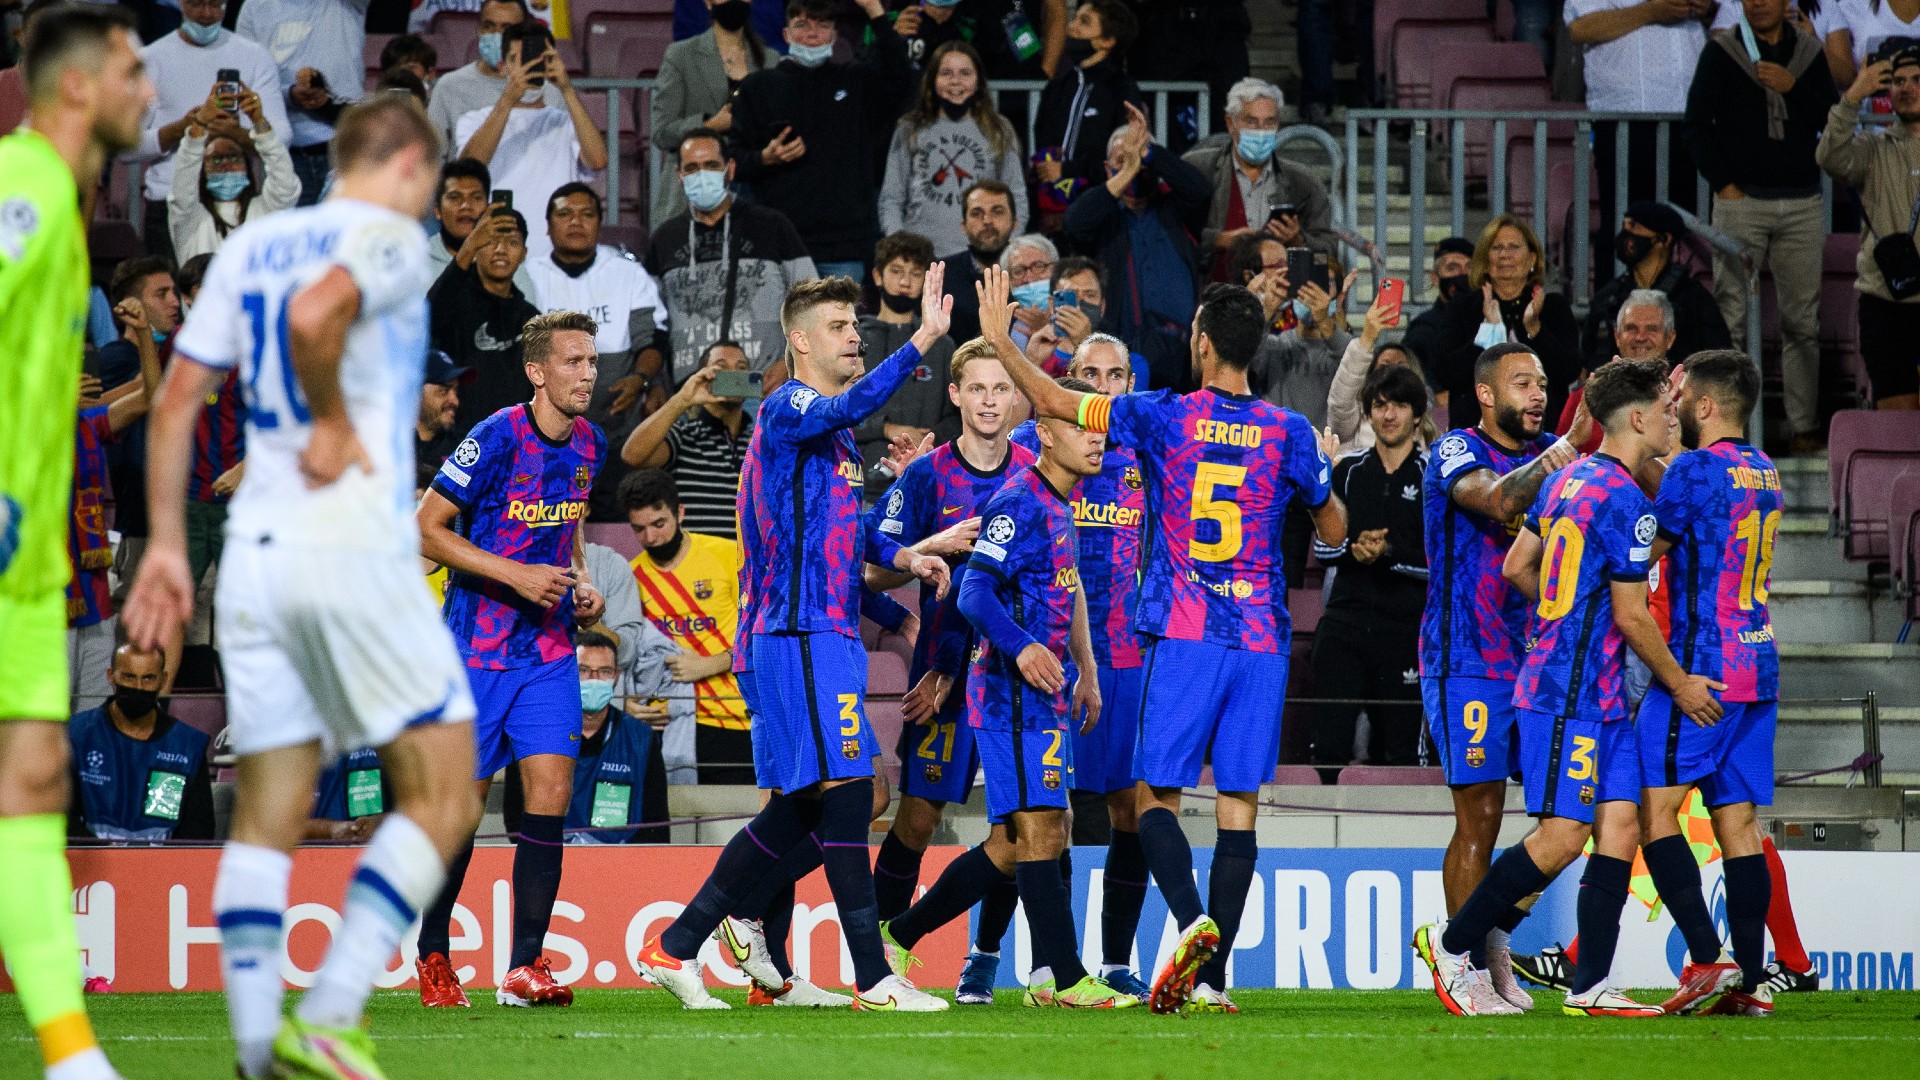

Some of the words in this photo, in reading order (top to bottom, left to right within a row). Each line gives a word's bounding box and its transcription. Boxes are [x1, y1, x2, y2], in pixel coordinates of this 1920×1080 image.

[1194, 419, 1262, 449] SERGIO
[1727, 466, 1764, 490] JORDI
[507, 499, 585, 522] Rakuten
[1069, 497, 1142, 527] akuten
[1188, 461, 1249, 562] 5
[654, 615, 717, 634] akuten
[837, 693, 860, 736] 3
[1463, 700, 1489, 744] 9
[917, 719, 956, 762] 21
[1042, 729, 1062, 766] 2
[1813, 826, 1826, 838] 10
[1768, 951, 1914, 991] PROM
